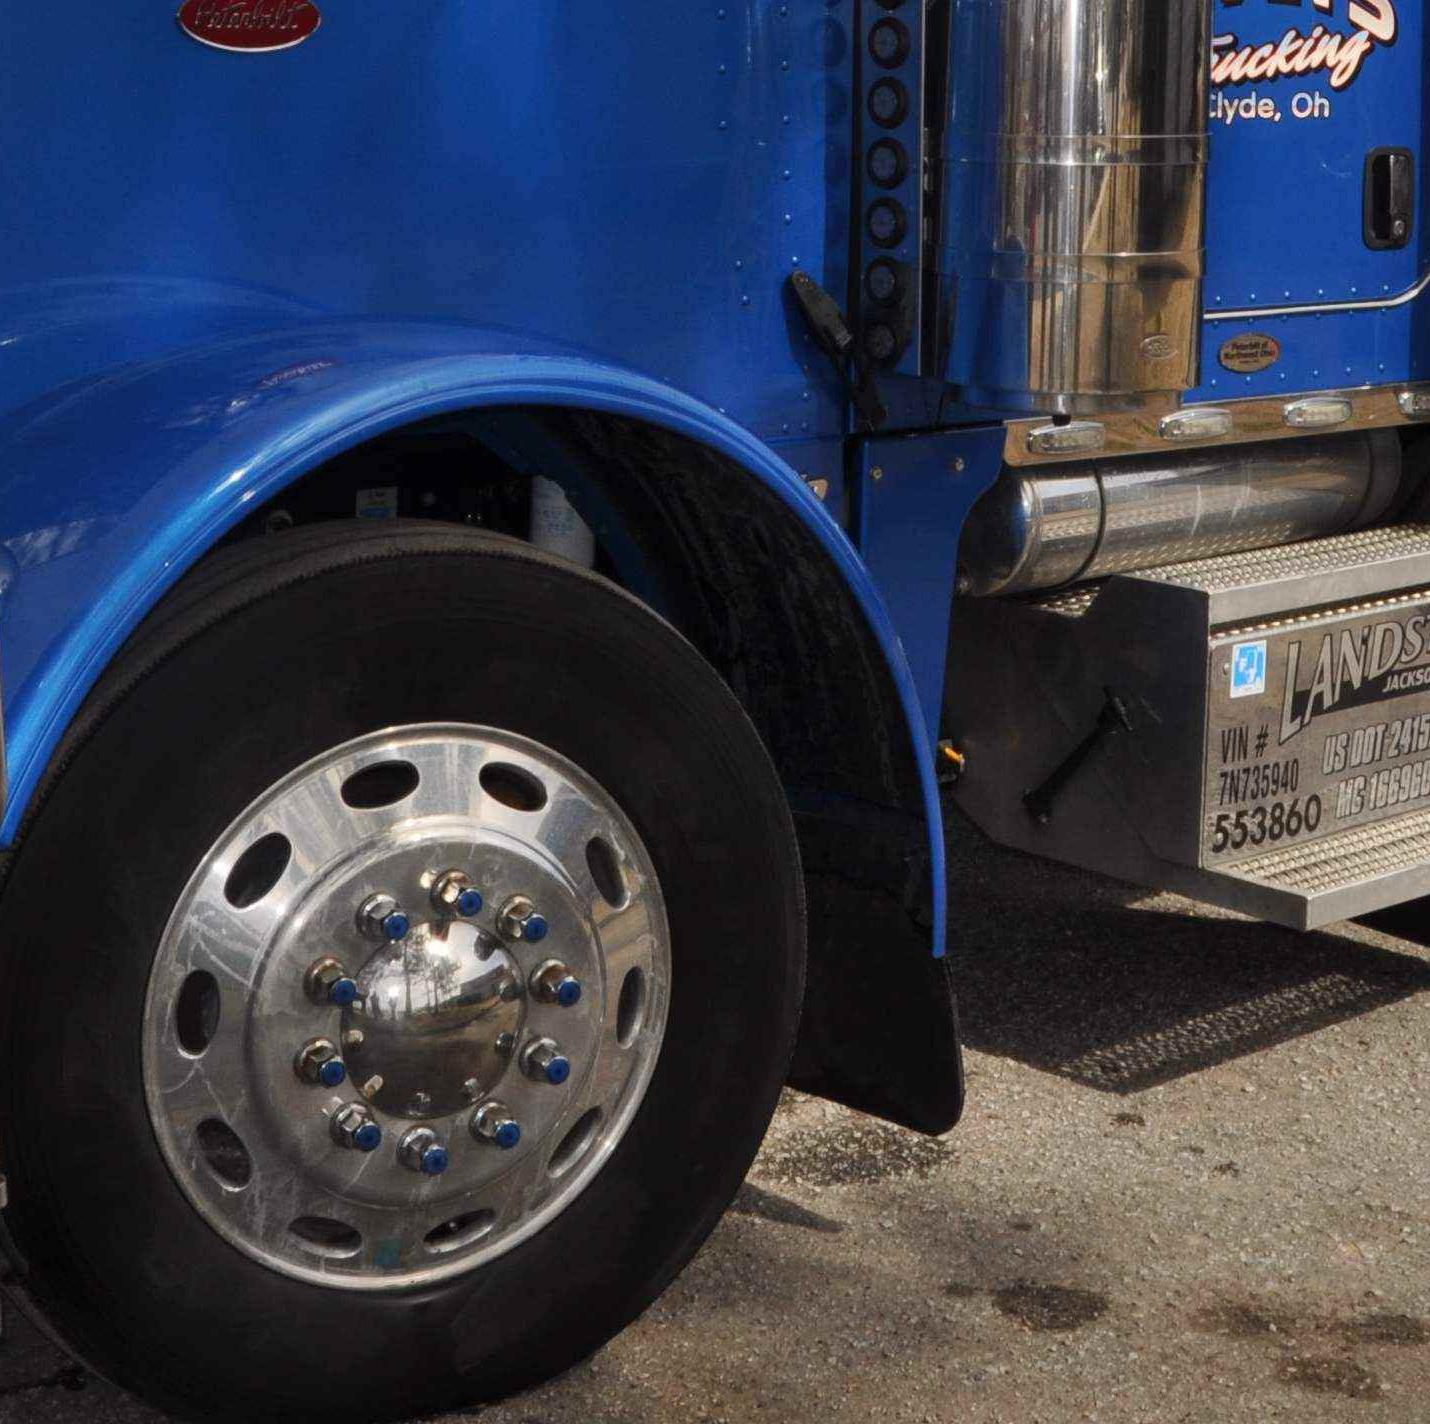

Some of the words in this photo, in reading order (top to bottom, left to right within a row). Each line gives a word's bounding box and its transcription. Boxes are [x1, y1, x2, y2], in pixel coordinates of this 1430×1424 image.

[1291, 91, 1331, 119] Oh
[1221, 725, 1249, 764] VIN
[1255, 723, 1269, 758] #
[1322, 732, 1350, 775] US
[1350, 723, 1388, 768] DOT
[1220, 758, 1299, 806] 7N735940
[1212, 793, 1322, 853] 553860
